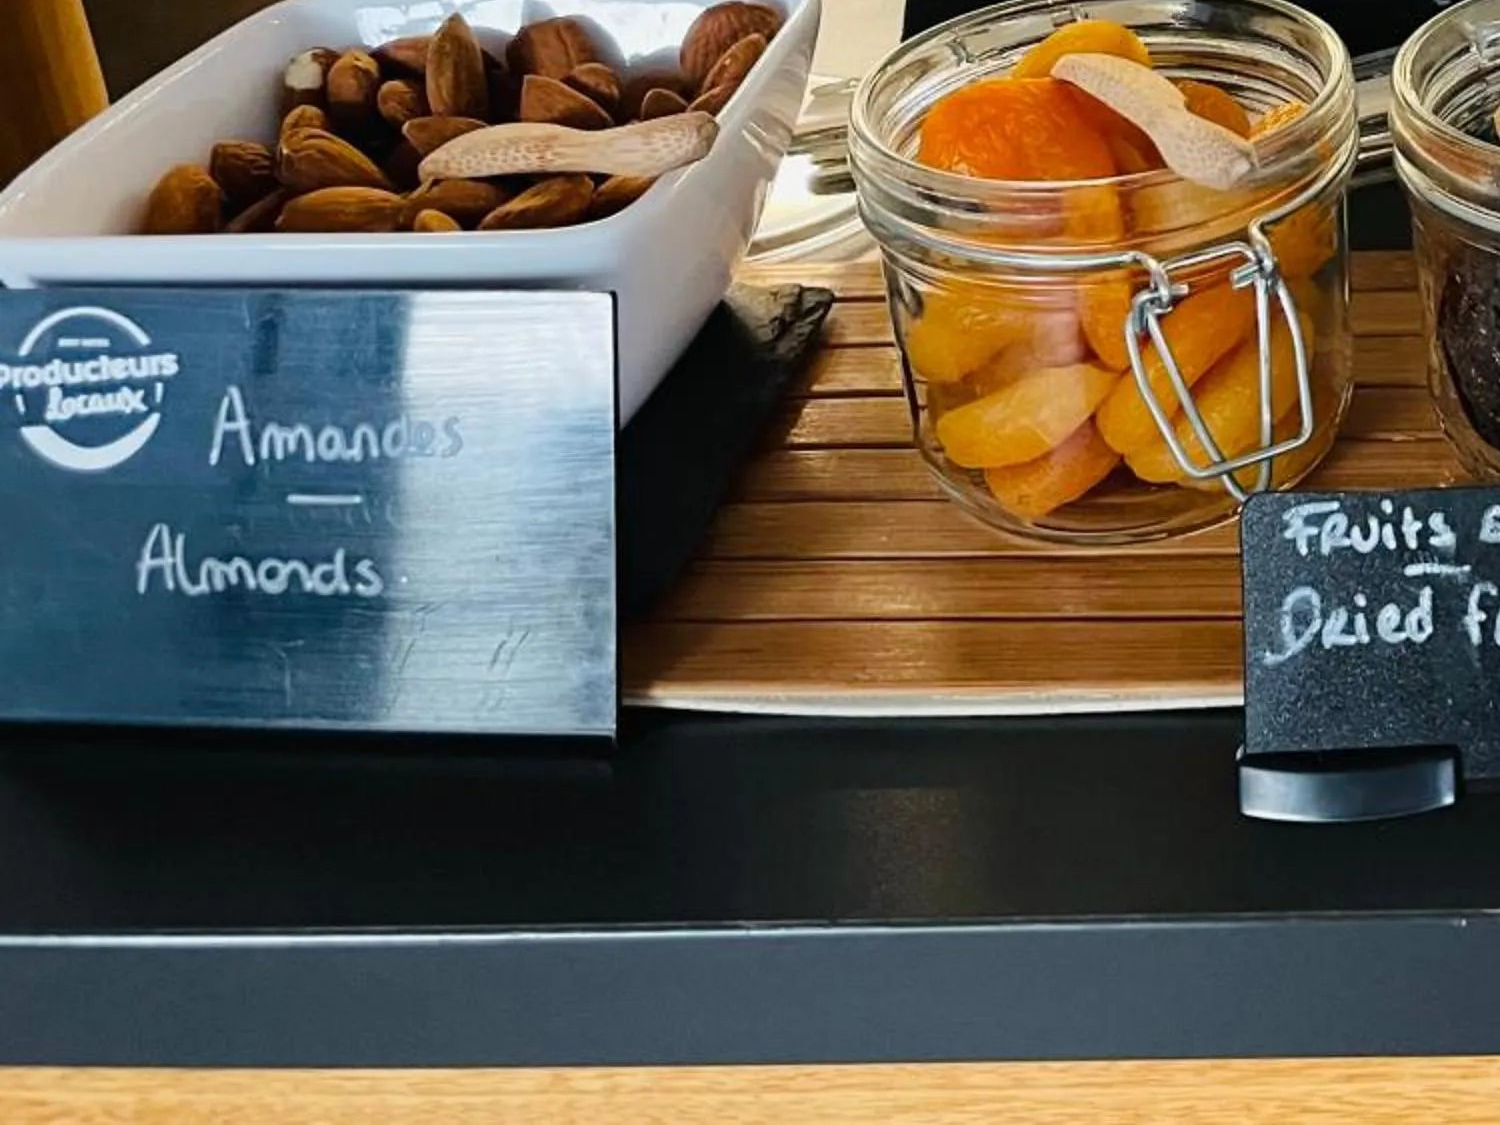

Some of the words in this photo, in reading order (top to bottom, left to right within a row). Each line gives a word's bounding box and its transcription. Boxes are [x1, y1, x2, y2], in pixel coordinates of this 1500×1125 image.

[0, 353, 179, 390] Producteurs
[209, 385, 465, 466] Amandes
[136, 522, 385, 596] Almonds
[1282, 499, 1456, 555] Fruits
[1261, 585, 1433, 665] Dried
